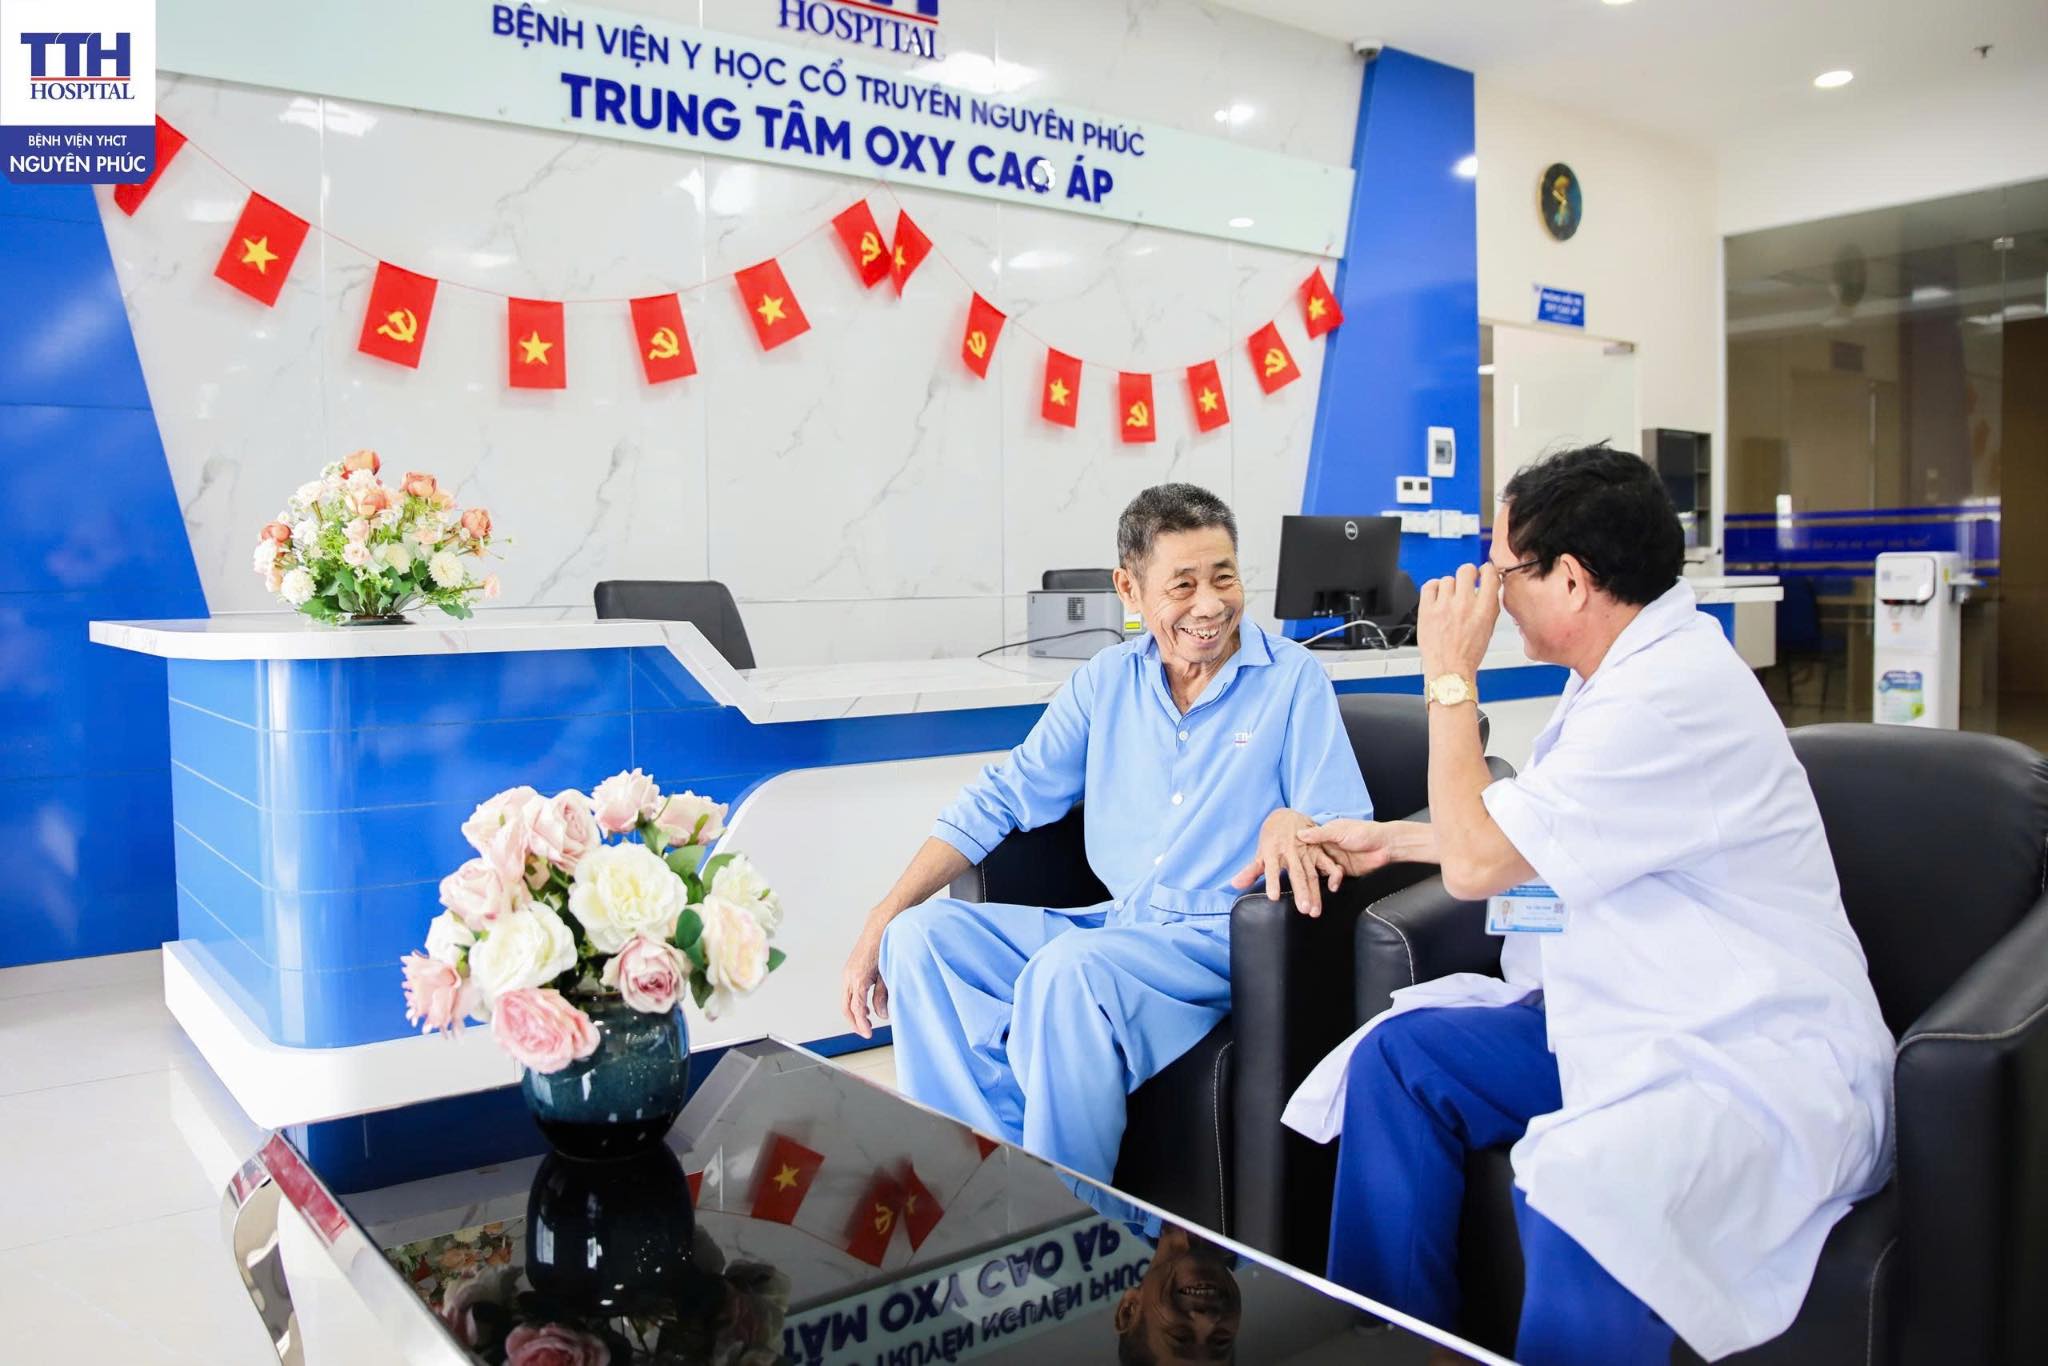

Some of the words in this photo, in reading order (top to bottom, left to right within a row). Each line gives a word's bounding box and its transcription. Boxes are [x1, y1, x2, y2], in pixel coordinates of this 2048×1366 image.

[493, 3, 583, 49] BỆNH
[596, 24, 669, 68] VIỆN
[681, 40, 702, 70] Y
[715, 46, 787, 89] HỌC
[799, 58, 846, 96] CỔ
[971, 98, 1074, 143] NGUYÊN
[1083, 122, 1145, 156] PHÚC
[777, 0, 945, 61] HOSPITAL
[561, 72, 741, 141] TRUNG
[756, 99, 850, 160] TÂM
[865, 125, 956, 176] OXY
[968, 144, 1056, 194] CAO
[1066, 154, 1114, 203] ÁP
